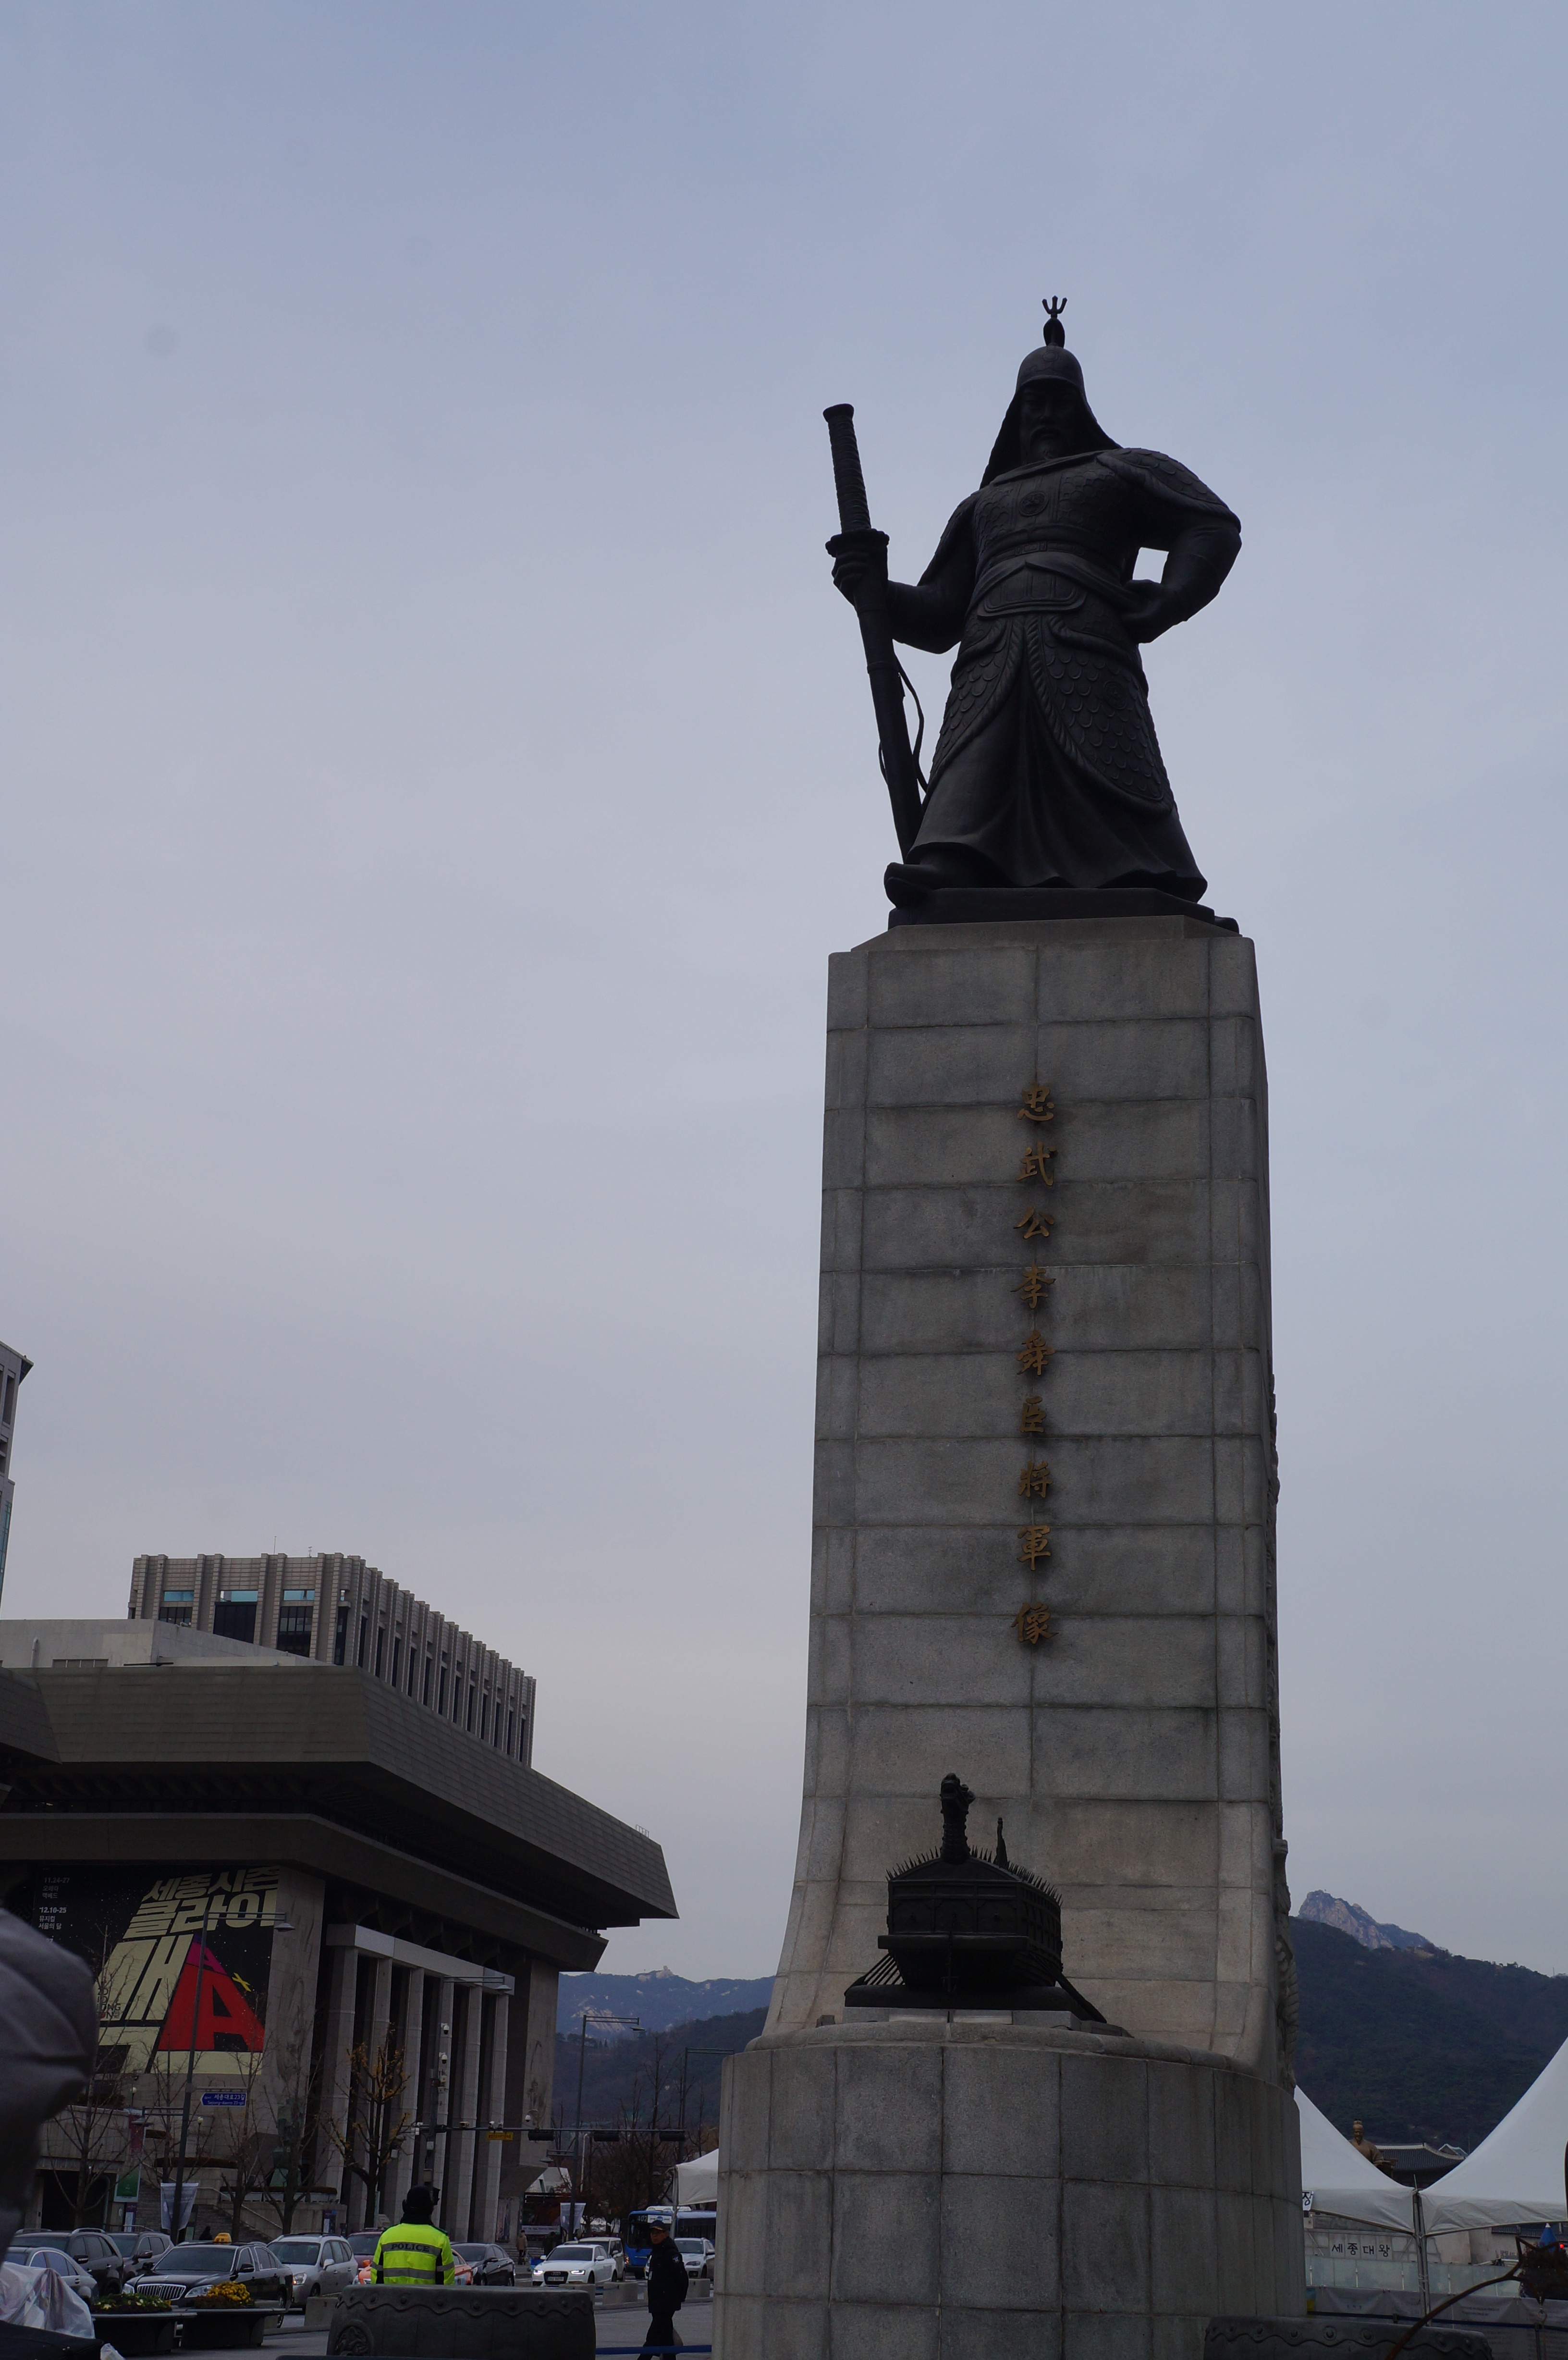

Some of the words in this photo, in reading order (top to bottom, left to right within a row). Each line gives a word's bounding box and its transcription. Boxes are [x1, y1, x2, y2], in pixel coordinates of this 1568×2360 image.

[1010, 1082, 1059, 1644] 忠武公李舜臣將軍像
[122, 1889, 277, 1939] 클라이
[392, 2243, 430, 2252] POLICE
[1332, 2243, 1390, 2257] 세종대왕
